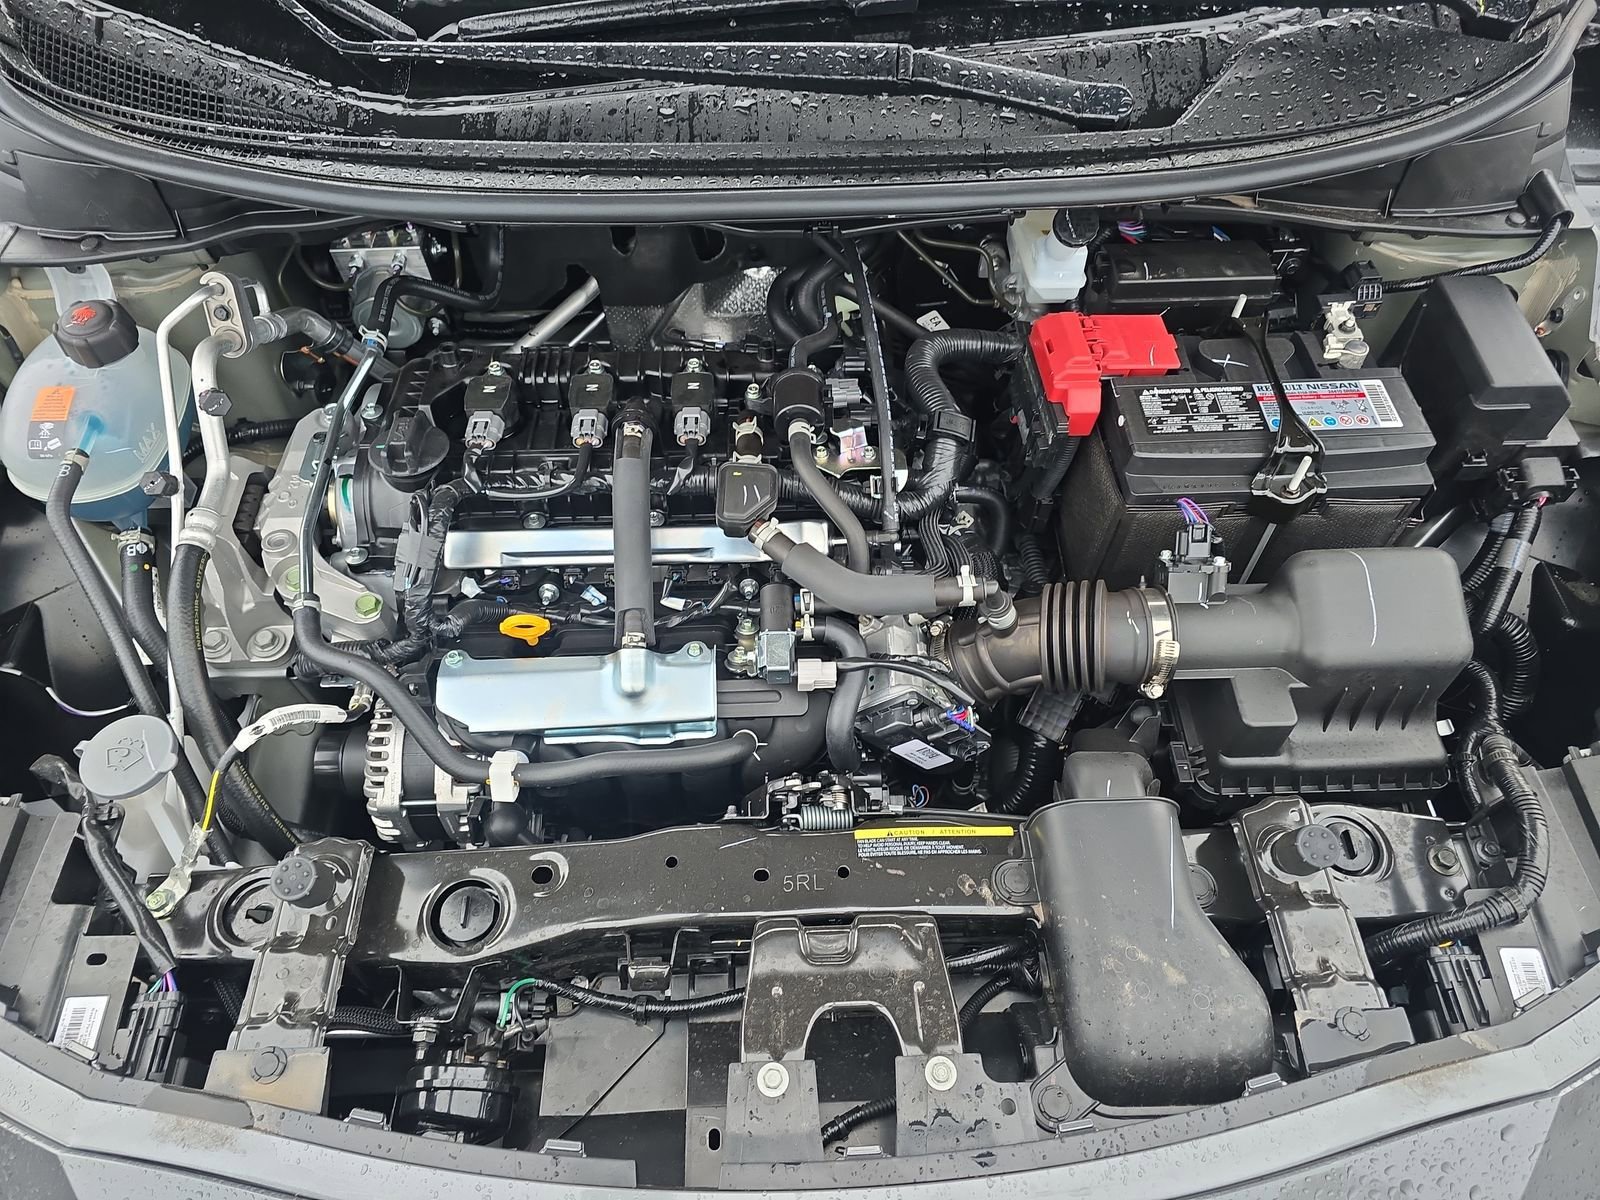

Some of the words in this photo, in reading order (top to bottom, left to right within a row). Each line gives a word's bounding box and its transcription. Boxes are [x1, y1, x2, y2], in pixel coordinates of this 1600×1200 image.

[930, 316, 942, 327] EA
[1256, 383, 1303, 392] REULT
[1306, 382, 1360, 390] NISSAN
[133, 422, 162, 463] MAX
[126, 544, 136, 556] B
[783, 874, 825, 892] 5RL
